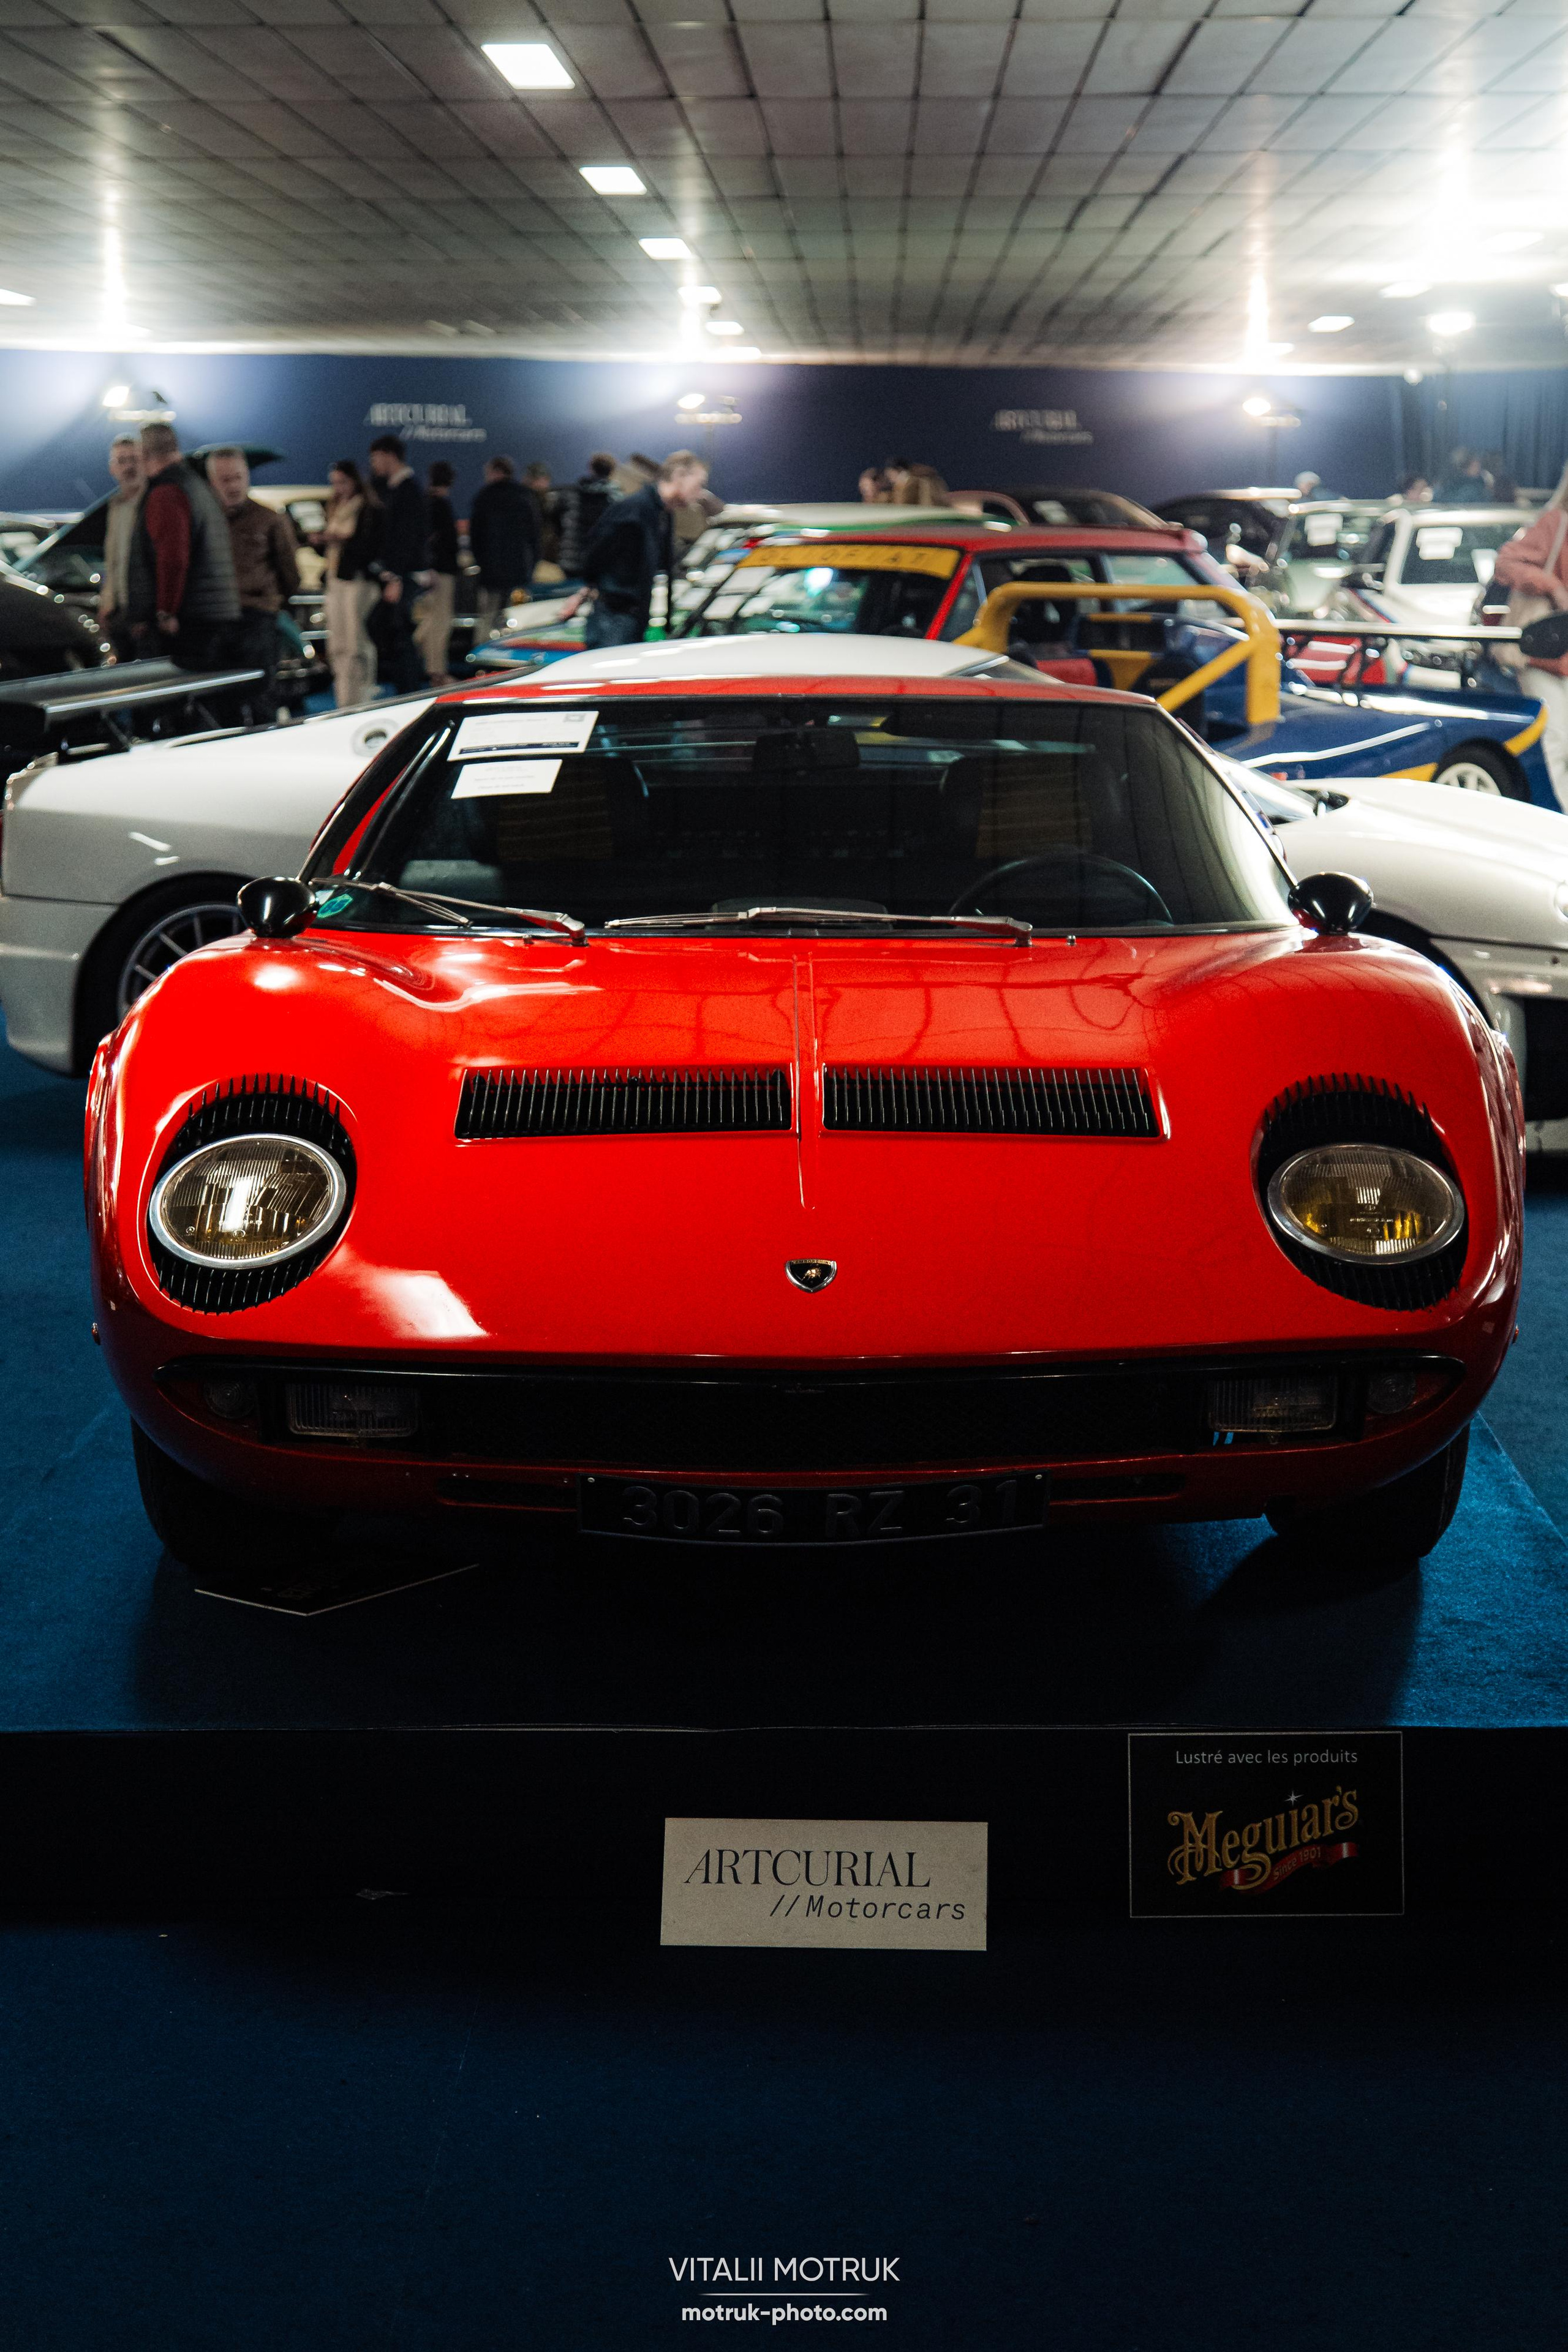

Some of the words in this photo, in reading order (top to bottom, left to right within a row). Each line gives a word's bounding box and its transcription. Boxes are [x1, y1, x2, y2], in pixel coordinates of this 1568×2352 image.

[621, 1485, 783, 1536] 3026
[825, 1490, 905, 1536] RZ
[944, 1479, 1017, 1528] 31
[1176, 1749, 1223, 1764] Lustré
[1227, 1752, 1262, 1764] avec
[1267, 1749, 1289, 1763] les
[1294, 1749, 1358, 1766] produits
[1167, 1785, 1359, 1890] Meguiar's
[683, 1848, 931, 1888] ARTCURIAL
[1273, 1856, 1297, 1882] Since
[1299, 1846, 1321, 1863] 1901
